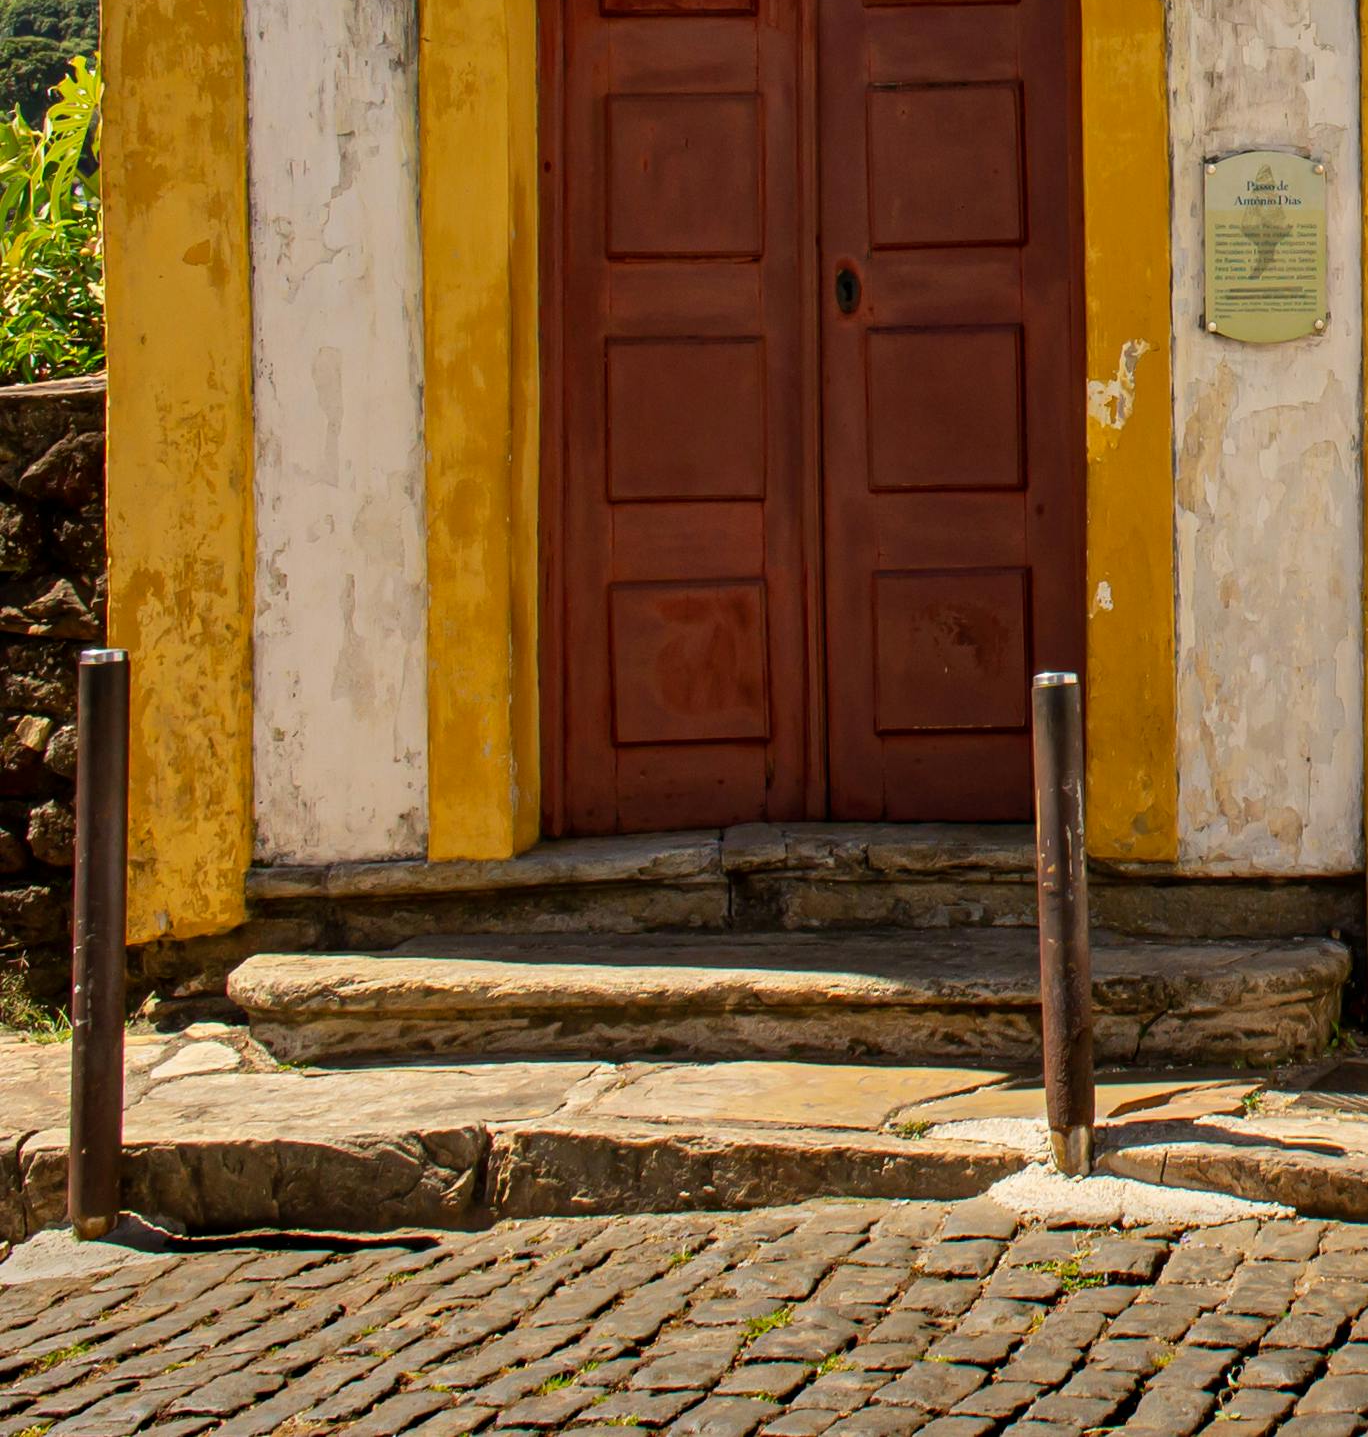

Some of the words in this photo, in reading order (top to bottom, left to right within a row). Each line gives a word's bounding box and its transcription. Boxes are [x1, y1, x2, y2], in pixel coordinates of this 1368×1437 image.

[1247, 181, 1276, 191] Passo
[1277, 179, 1289, 191] de
[1279, 195, 1303, 206] Dias
